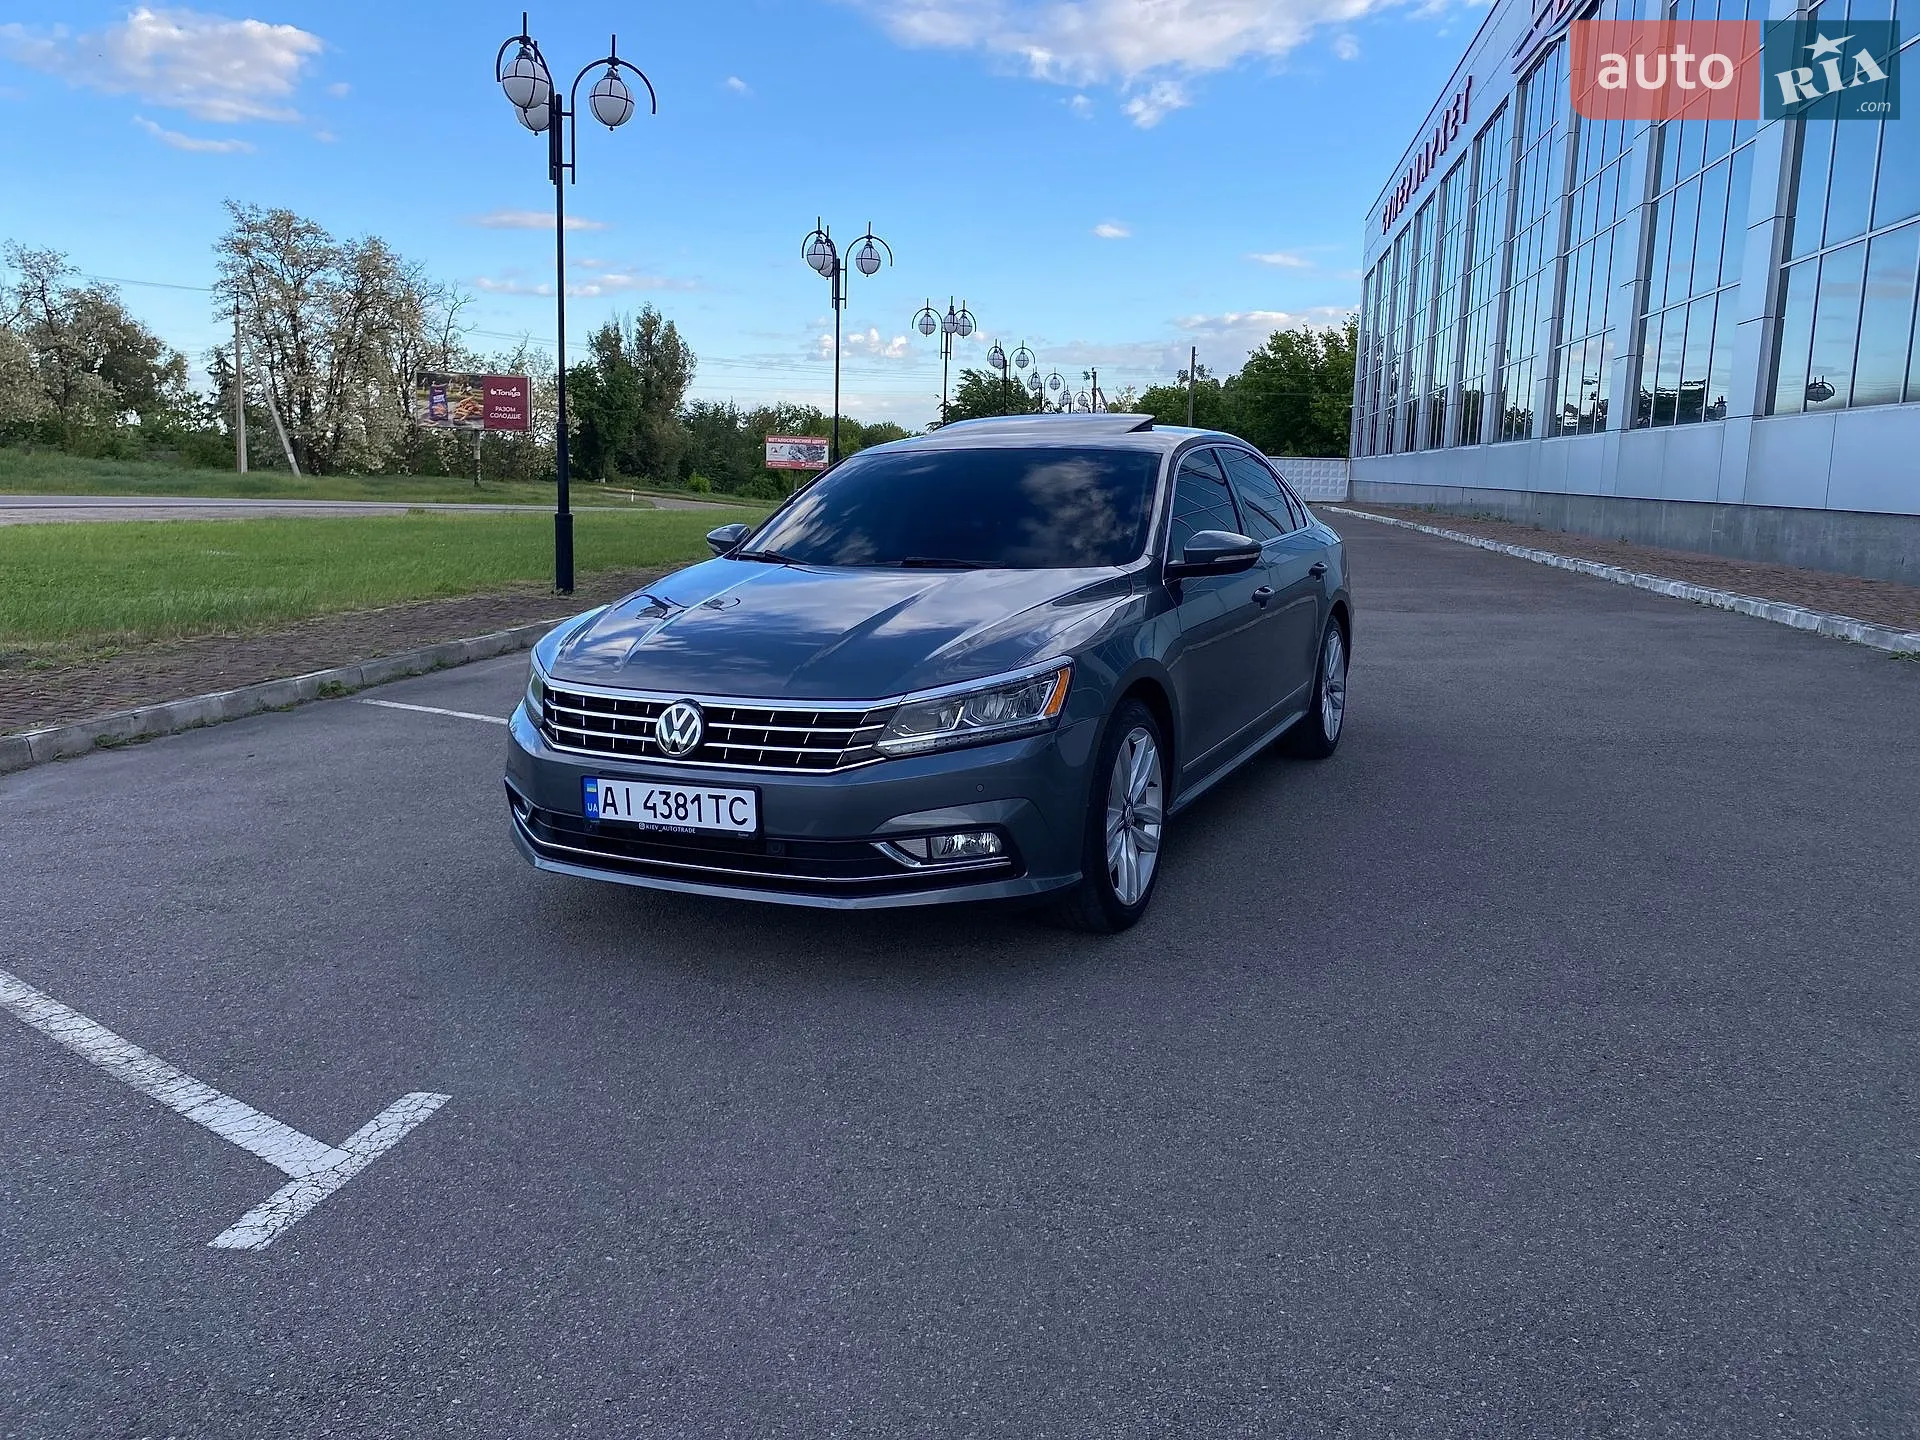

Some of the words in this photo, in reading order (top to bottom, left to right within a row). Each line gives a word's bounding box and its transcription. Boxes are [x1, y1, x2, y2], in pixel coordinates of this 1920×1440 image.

[489, 412, 521, 420] СОЛОДШЕ
[656, 703, 702, 755] VW
[587, 802, 599, 813] UA
